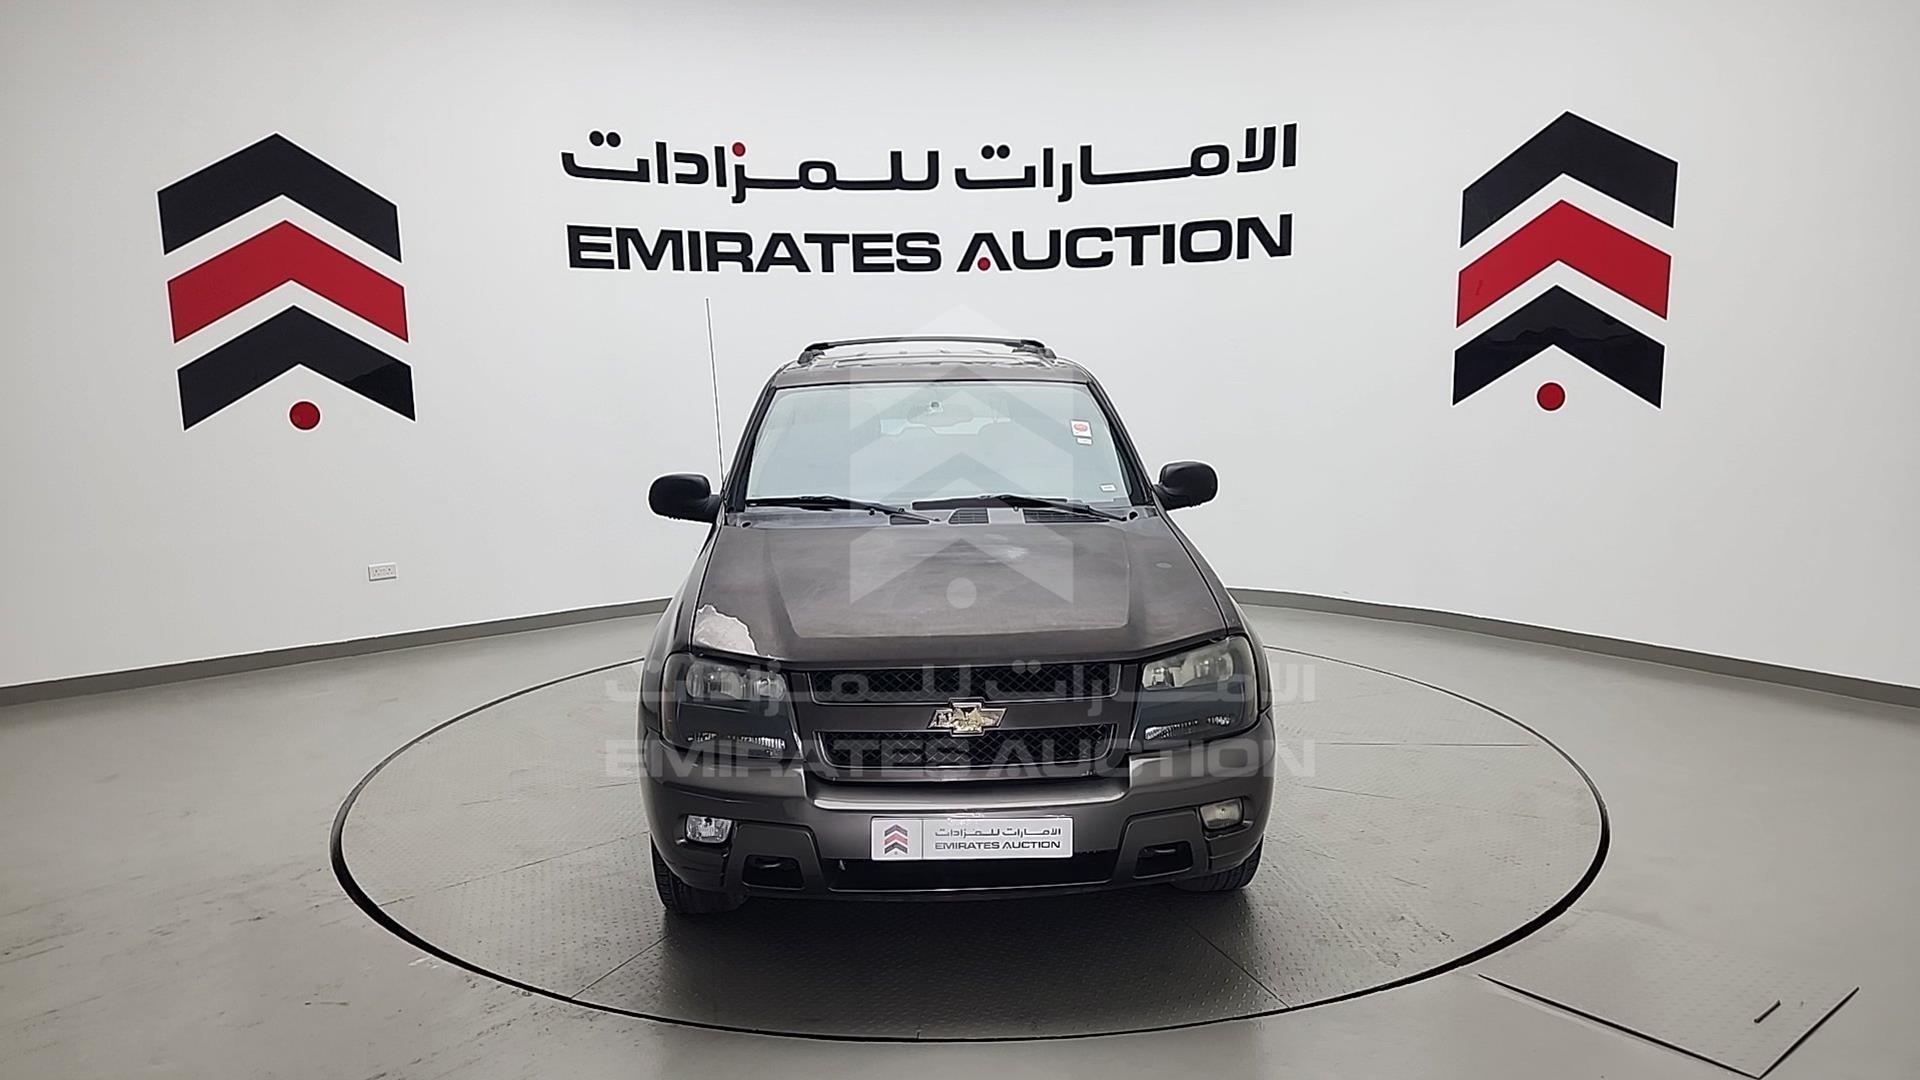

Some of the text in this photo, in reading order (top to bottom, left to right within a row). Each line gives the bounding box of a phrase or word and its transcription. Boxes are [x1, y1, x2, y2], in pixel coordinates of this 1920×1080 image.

[561, 122, 1297, 204] الامارات للمزادات
[566, 213, 1293, 273] EMIRATES AUCTION
[935, 841, 1061, 850] EMIRATES AUCTION
